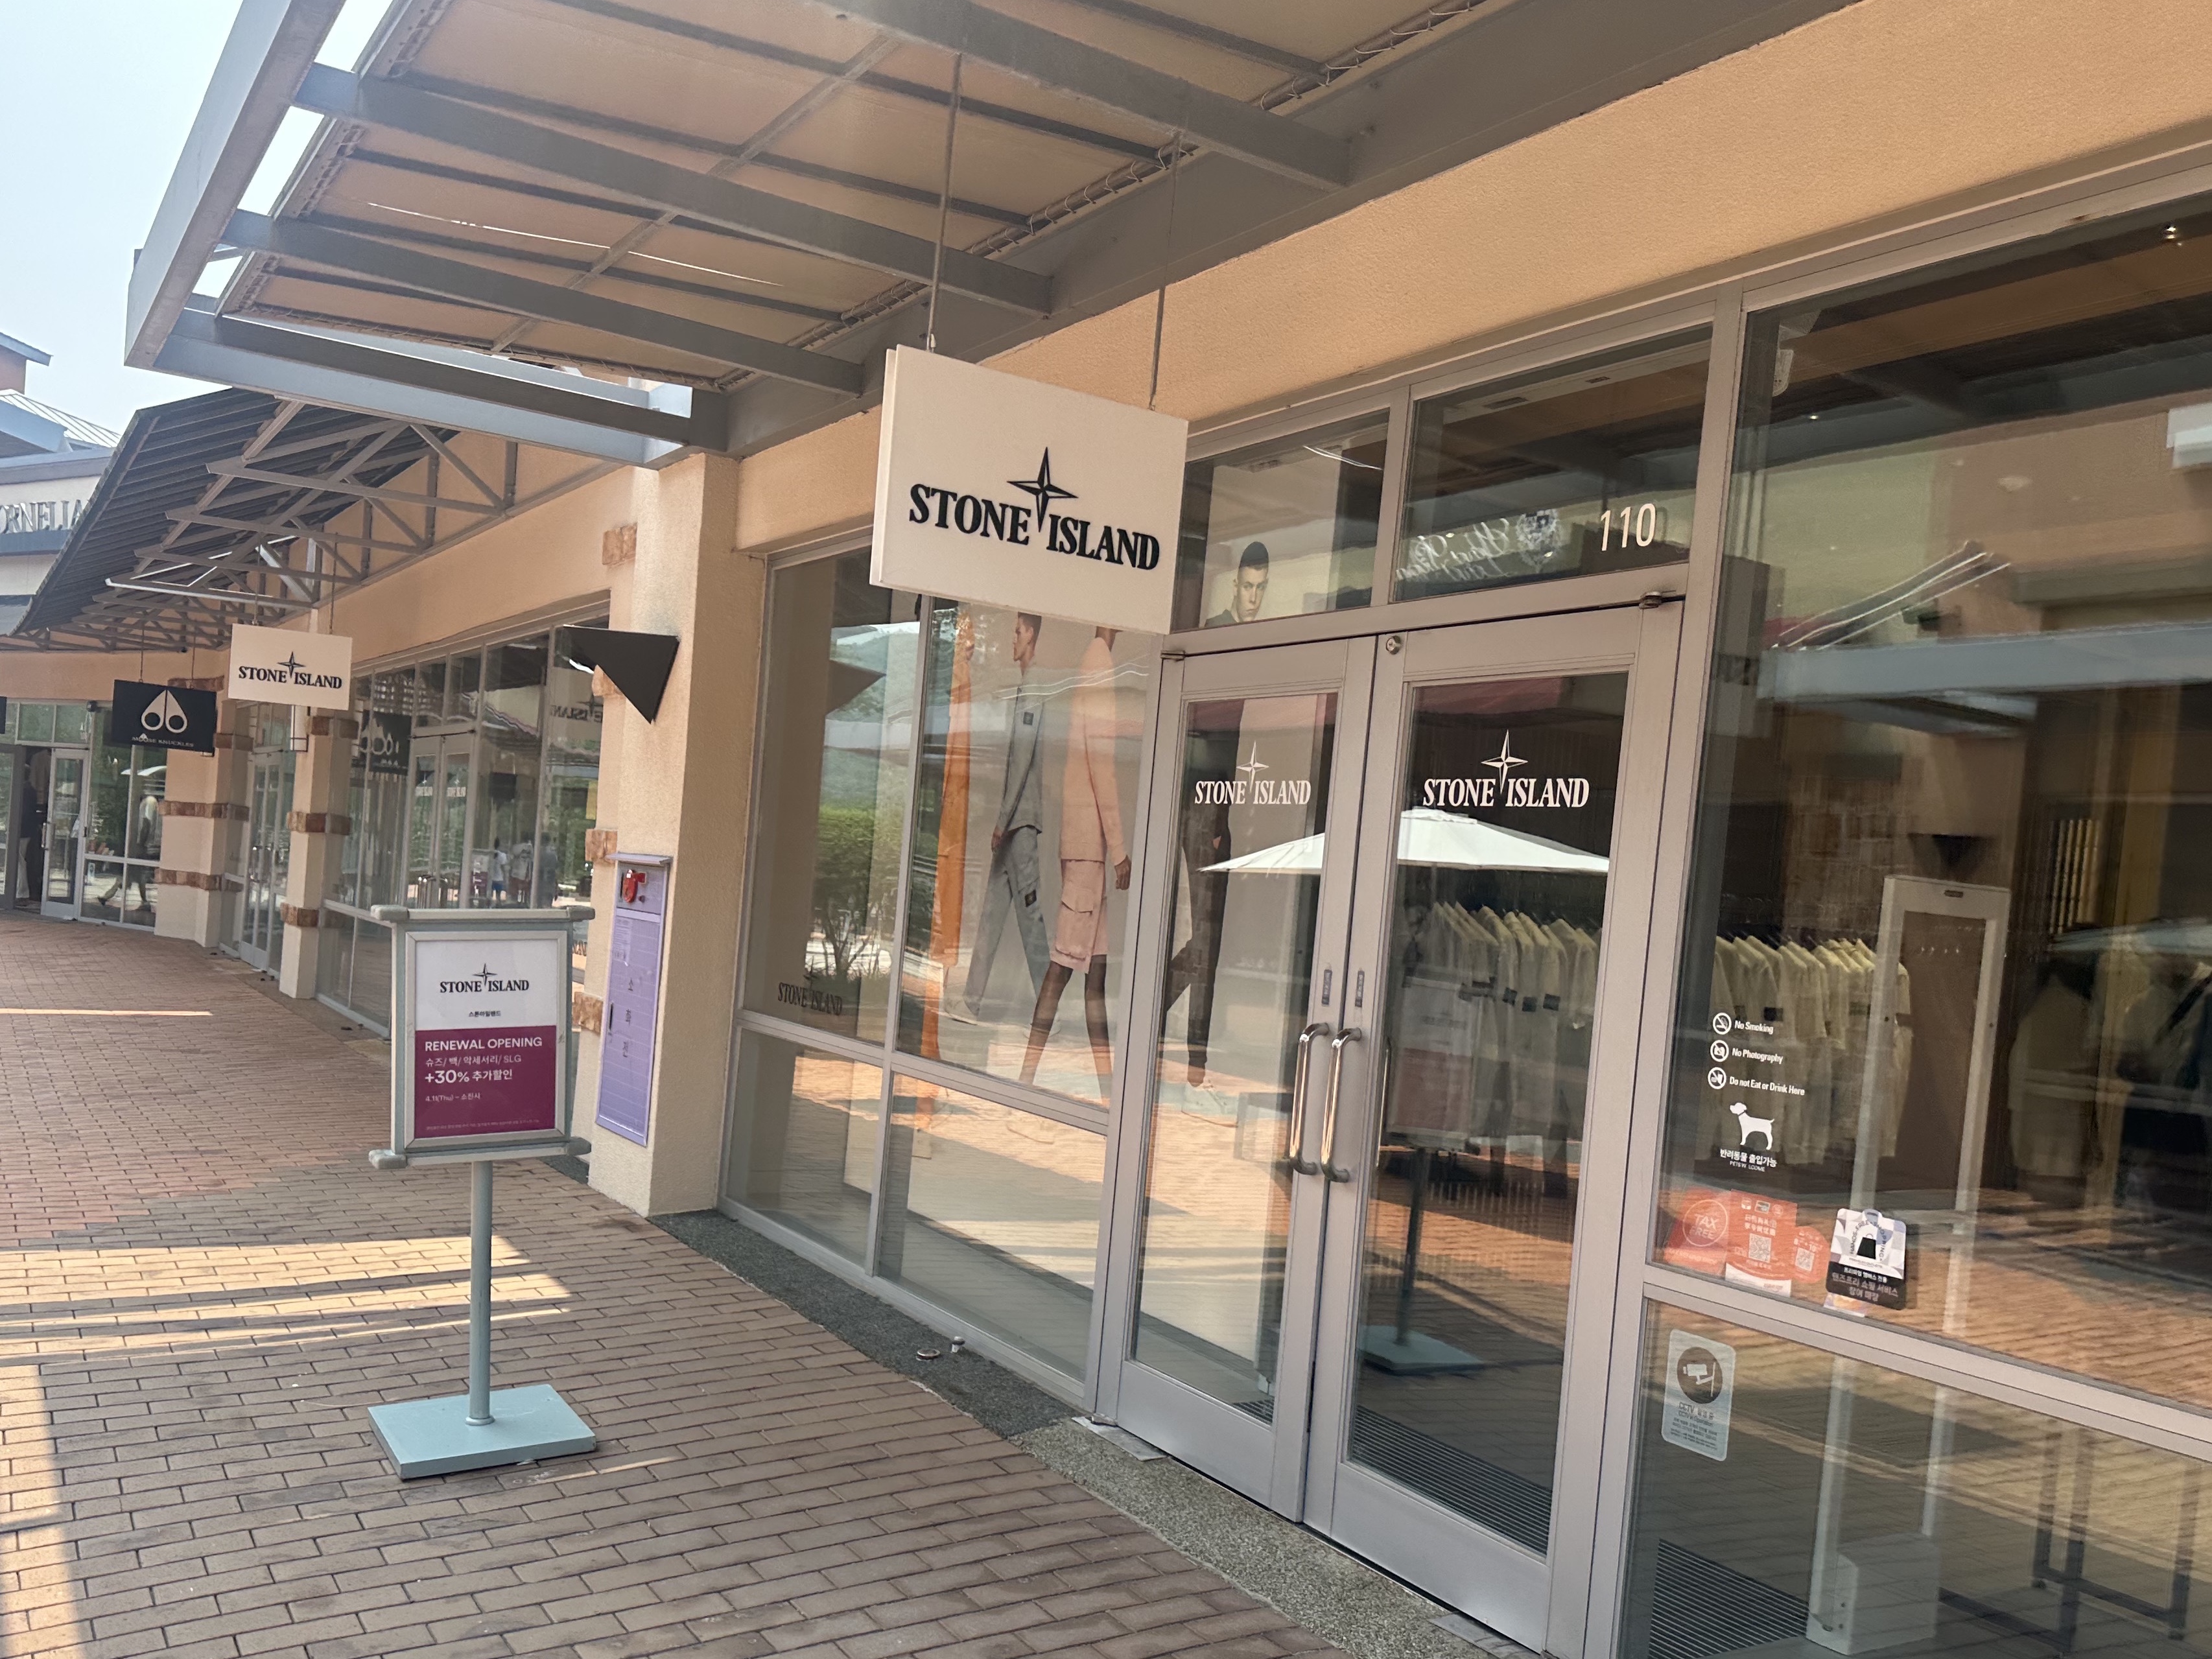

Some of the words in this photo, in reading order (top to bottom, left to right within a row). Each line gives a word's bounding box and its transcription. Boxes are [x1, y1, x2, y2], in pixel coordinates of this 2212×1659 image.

[909, 483, 1031, 546] STONE
[1046, 513, 1160, 571] ISLAND
[1600, 503, 1656, 552] 110
[238, 665, 287, 684] STONE
[293, 671, 343, 690] ISLAND
[1194, 780, 1247, 805] STONE
[1253, 780, 1312, 805] ISLAND
[1422, 778, 1494, 808] STONE
[1504, 778, 1590, 808] ISLAND
[440, 980, 482, 993] STONE
[488, 979, 530, 993] ISLAND
[778, 982, 808, 1007] STONE
[810, 990, 843, 1016] ISLAND
[1734, 1020, 1745, 1030] No
[1745, 1022, 1774, 1035] Smoking
[425, 1039, 486, 1052] RENEWAL
[488, 1037, 543, 1049] OPENING
[425, 1057, 447, 1067] 슈즈/
[449, 1056, 462, 1066] 백/
[463, 1055, 502, 1065] 악세서리/
[503, 1055, 522, 1063] SLG
[1732, 1048, 1742, 1057] No
[1743, 1049, 1783, 1065] Photography
[425, 1069, 470, 1084] +30%
[472, 1068, 513, 1081] 추가할인
[1729, 1076, 1739, 1085] Do
[1739, 1079, 1750, 1087] not
[1750, 1079, 1761, 1089] Eat
[1769, 1082, 1787, 1093] Drink
[1788, 1085, 1806, 1096] Here
[1720, 1149, 1747, 1162] 반려동물
[1748, 1154, 1777, 1168] 출입가능
[1694, 1214, 1719, 1231] TAX
[1689, 1225, 1715, 1240] FREE
[1678, 1402, 1695, 1415] CCTV
